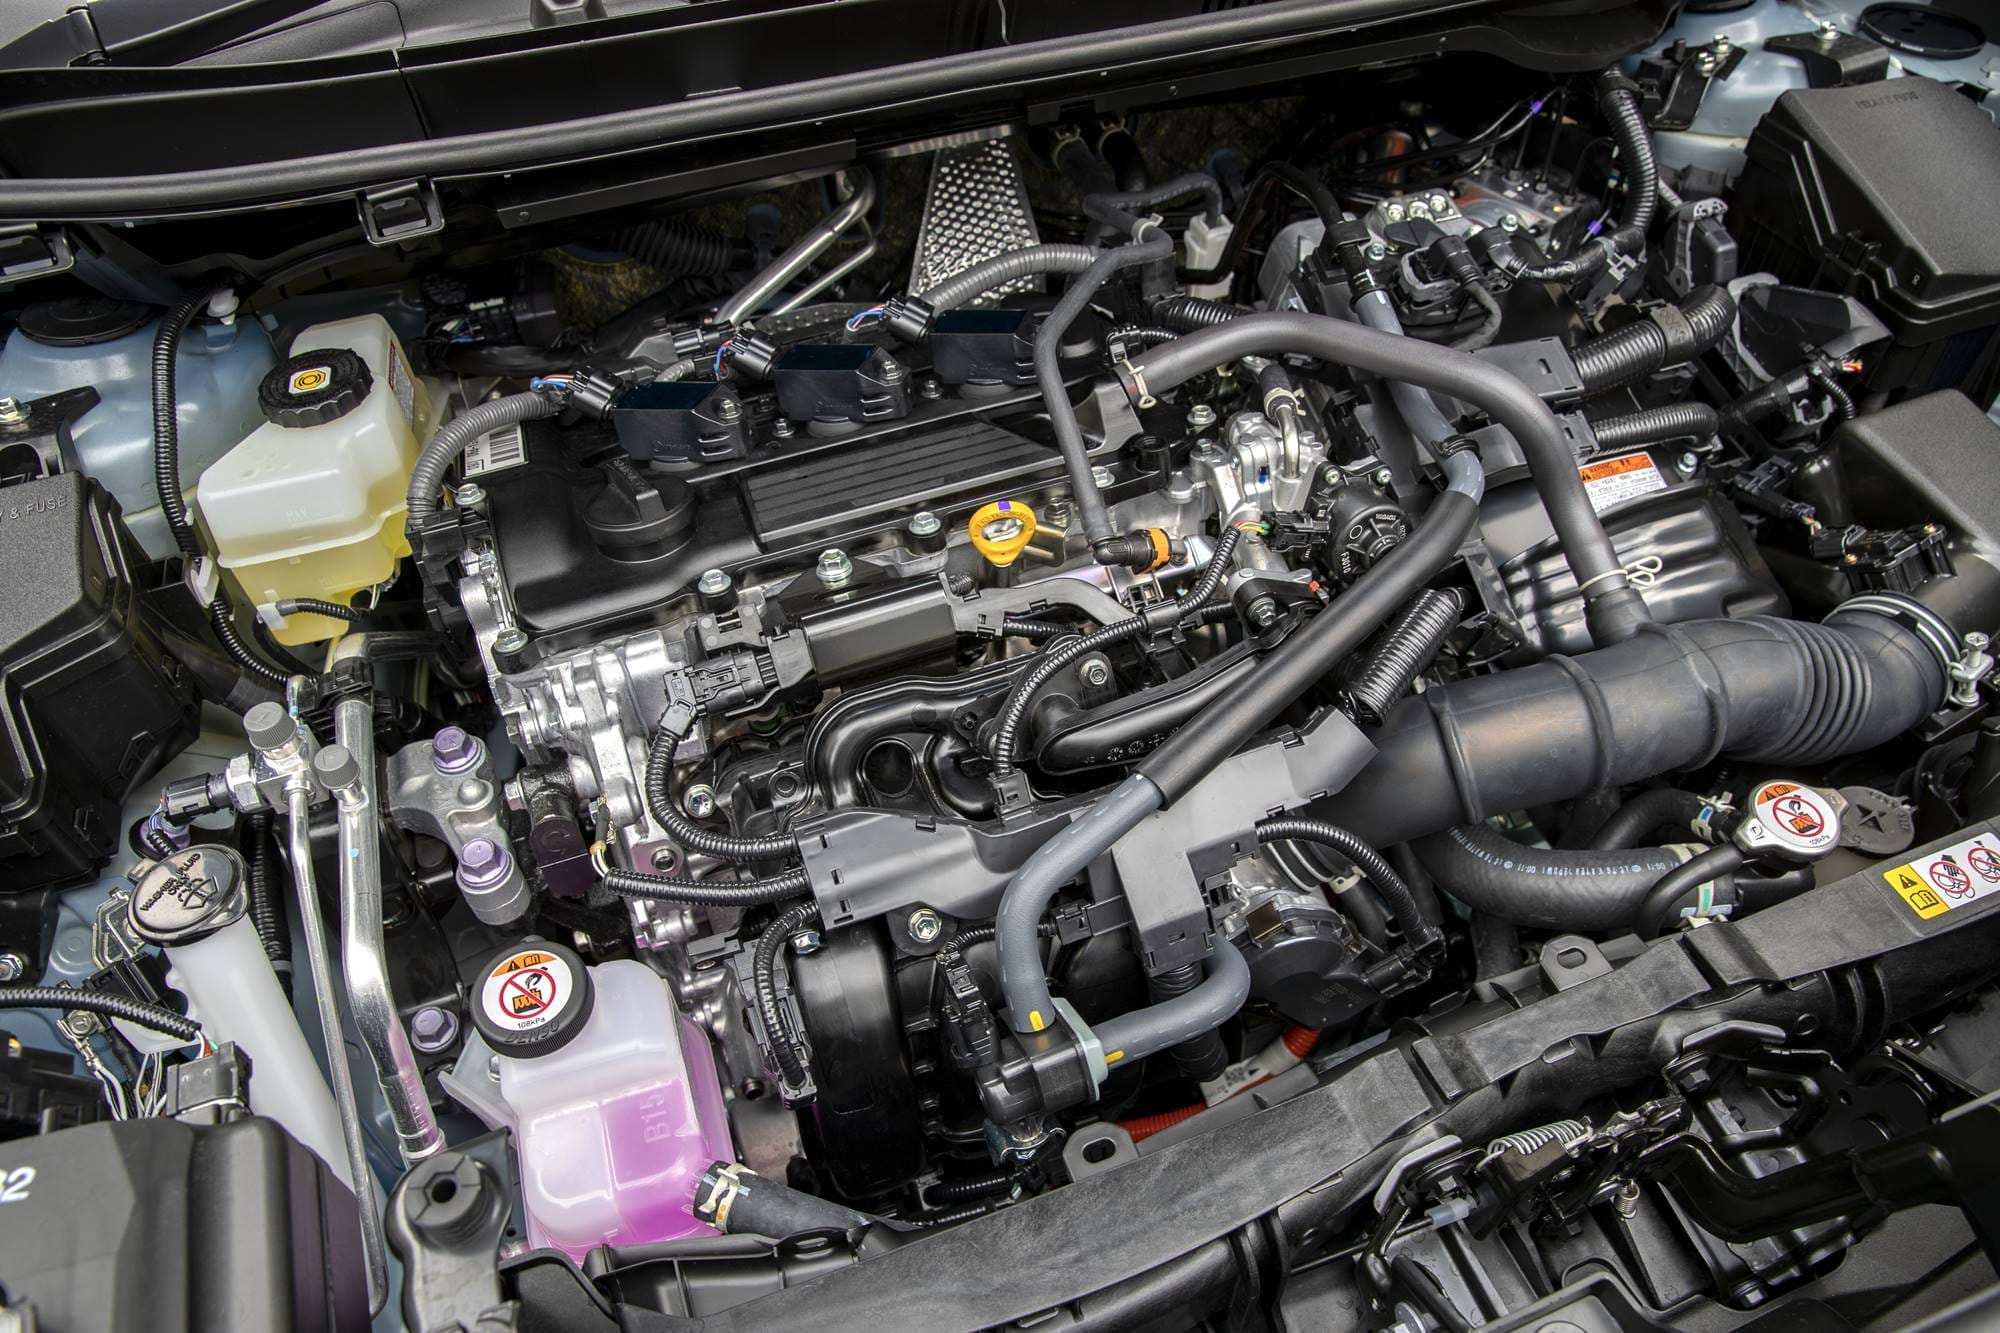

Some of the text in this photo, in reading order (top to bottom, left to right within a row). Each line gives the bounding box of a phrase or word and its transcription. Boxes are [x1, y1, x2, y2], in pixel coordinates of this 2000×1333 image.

[9, 507, 20, 519] &
[26, 496, 68, 515] FUSE
[504, 1021, 561, 1044] DENSO
[517, 1016, 546, 1029] 108kPa
